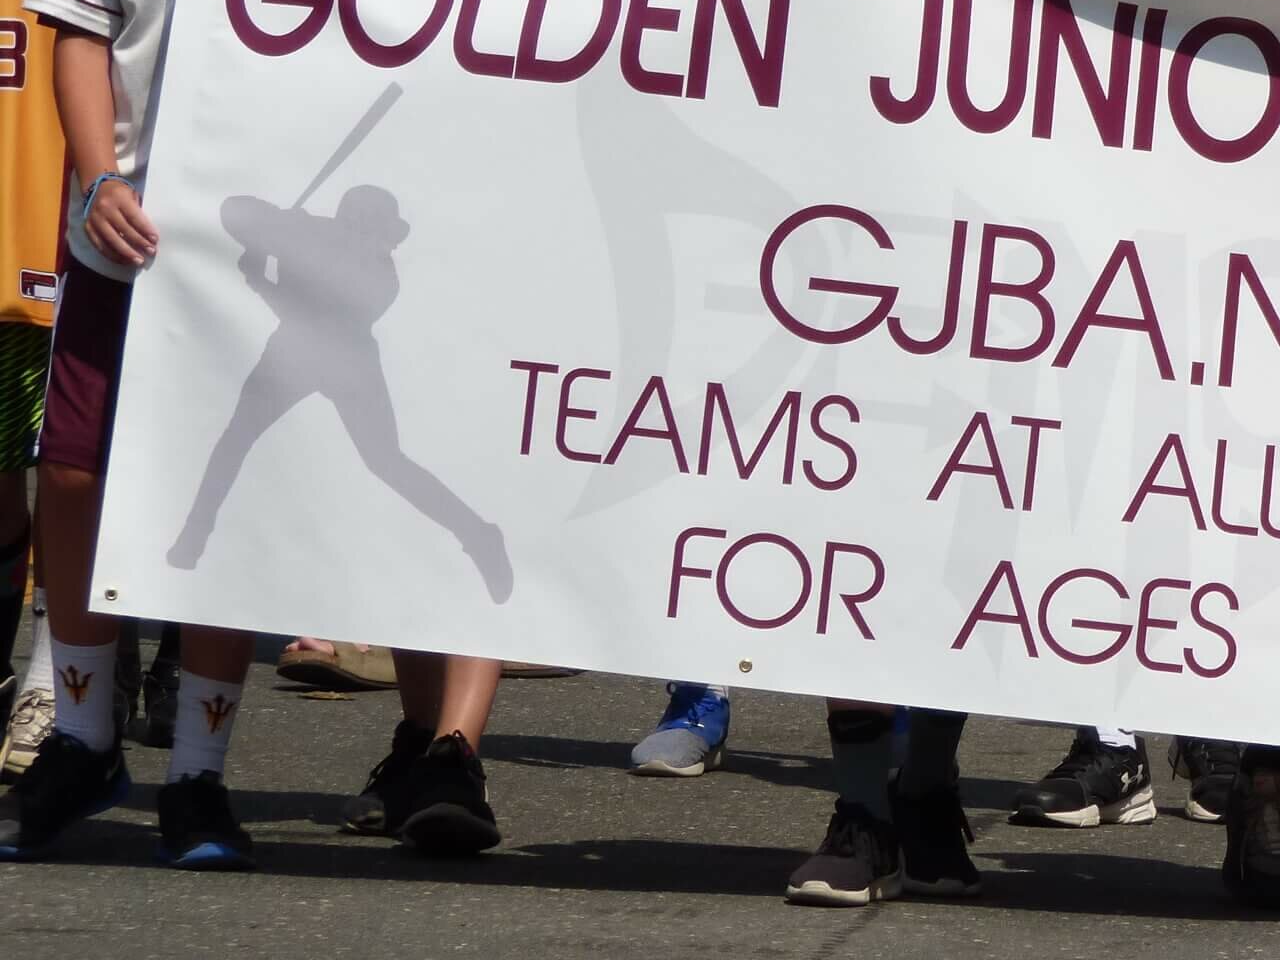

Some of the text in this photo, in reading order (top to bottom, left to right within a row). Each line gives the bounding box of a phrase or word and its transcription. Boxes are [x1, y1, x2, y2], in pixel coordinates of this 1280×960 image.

[511, 360, 859, 490] TEAMS
[927, 412, 1061, 511] AT
[668, 527, 884, 640] FOR
[951, 561, 1238, 678] AGES
